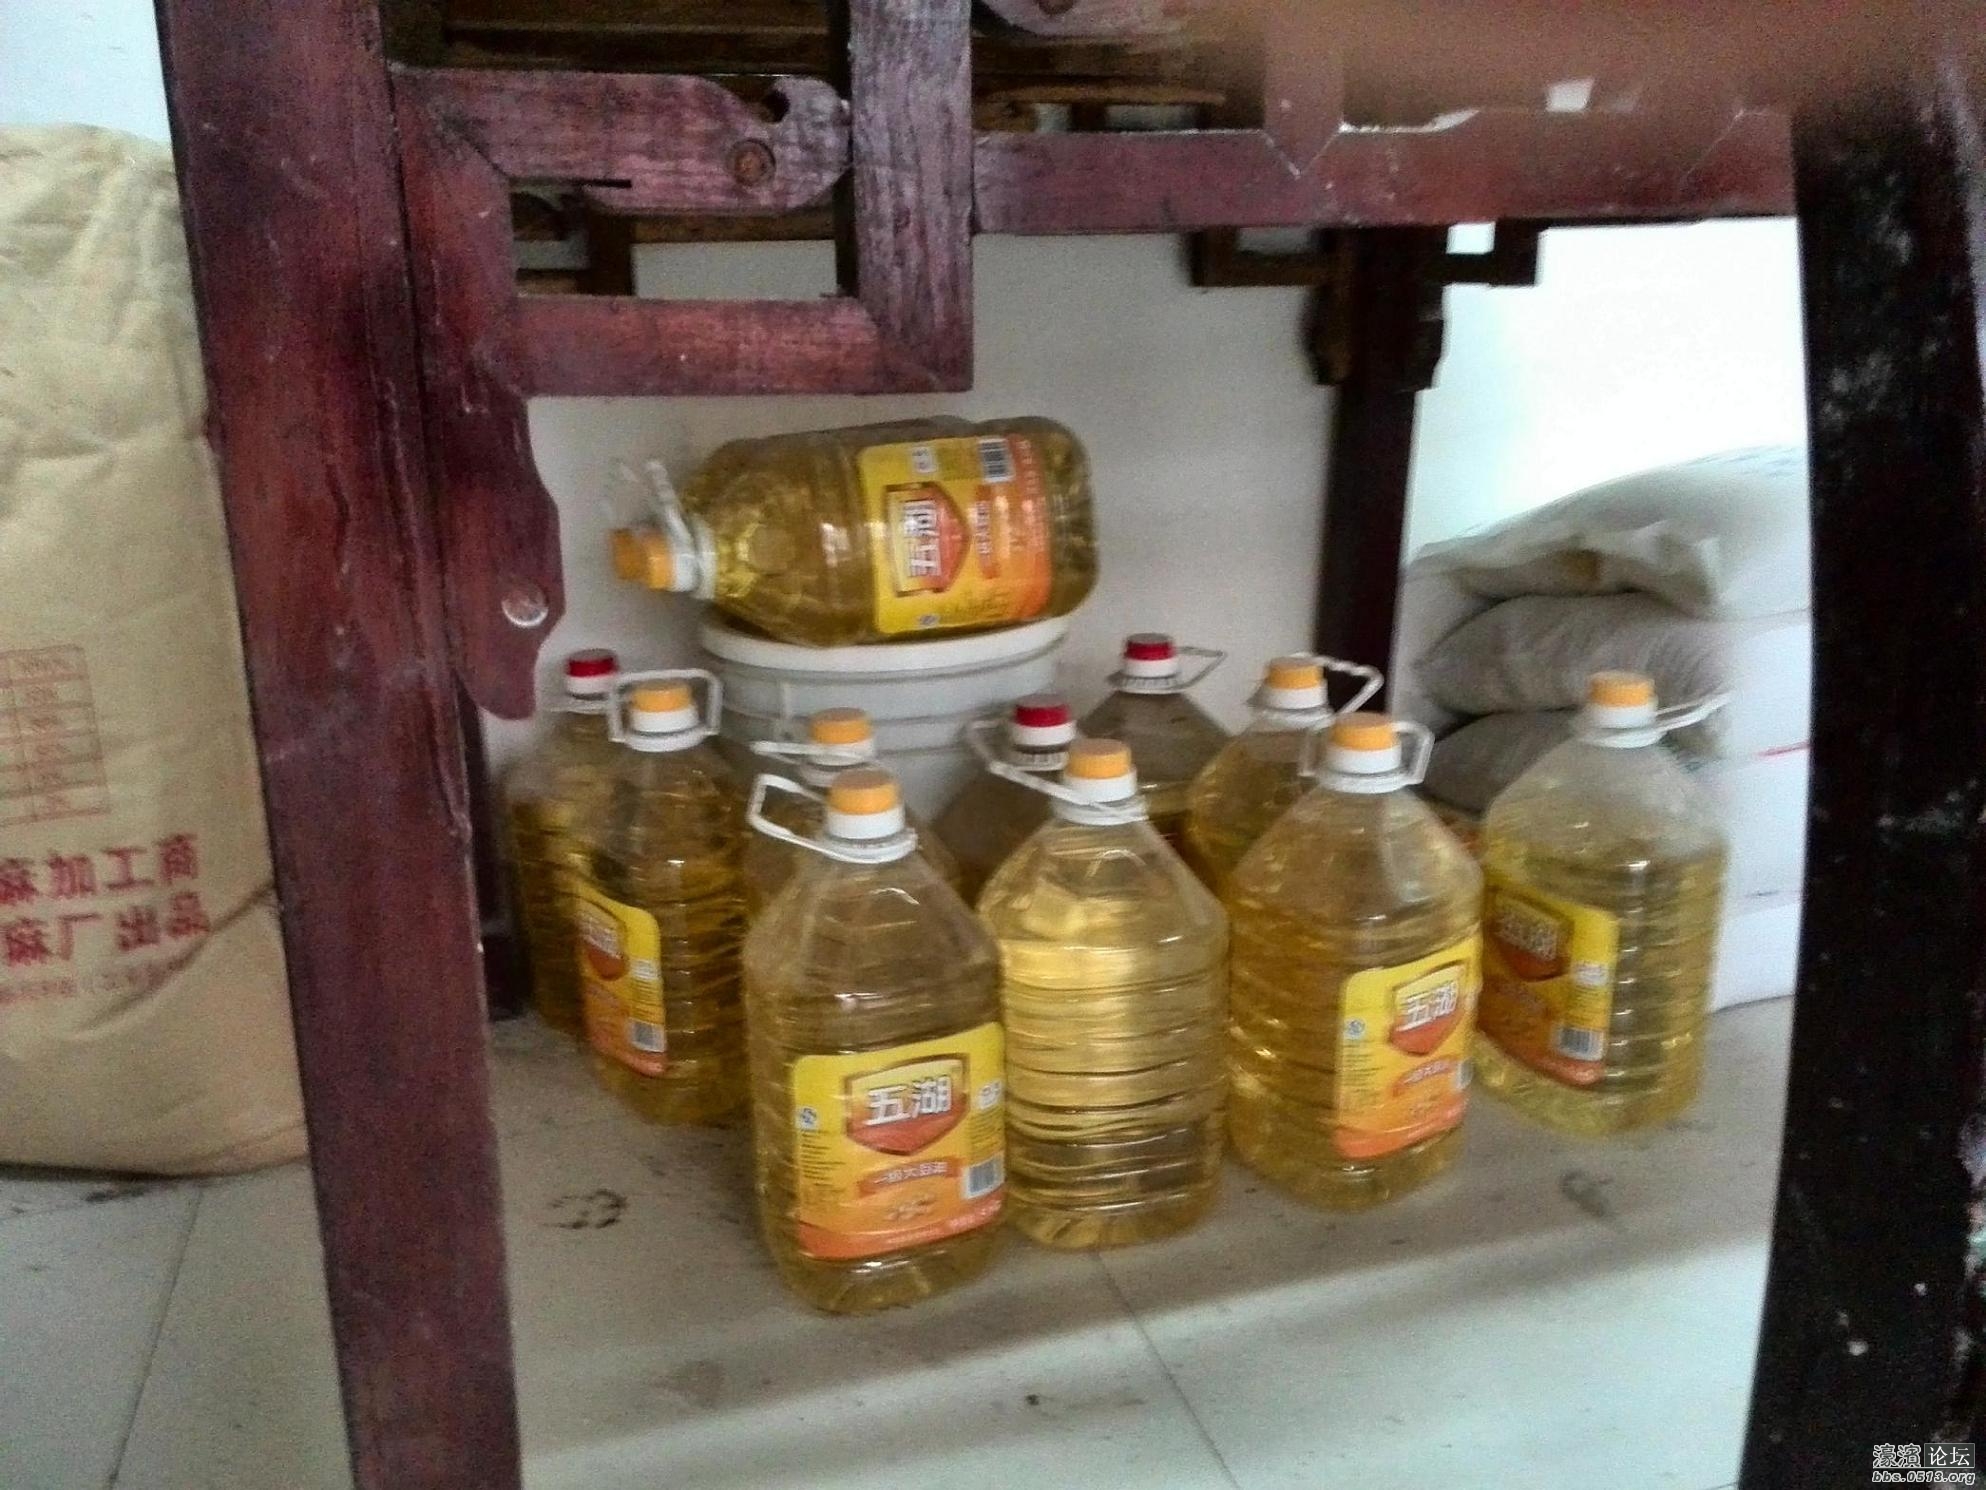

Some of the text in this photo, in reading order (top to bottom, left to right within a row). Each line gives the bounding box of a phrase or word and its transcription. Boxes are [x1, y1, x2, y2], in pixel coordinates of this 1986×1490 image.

[903, 499, 941, 577] 五湖
[1395, 980, 1458, 1034] 五湖
[864, 1074, 953, 1127] 五湖
